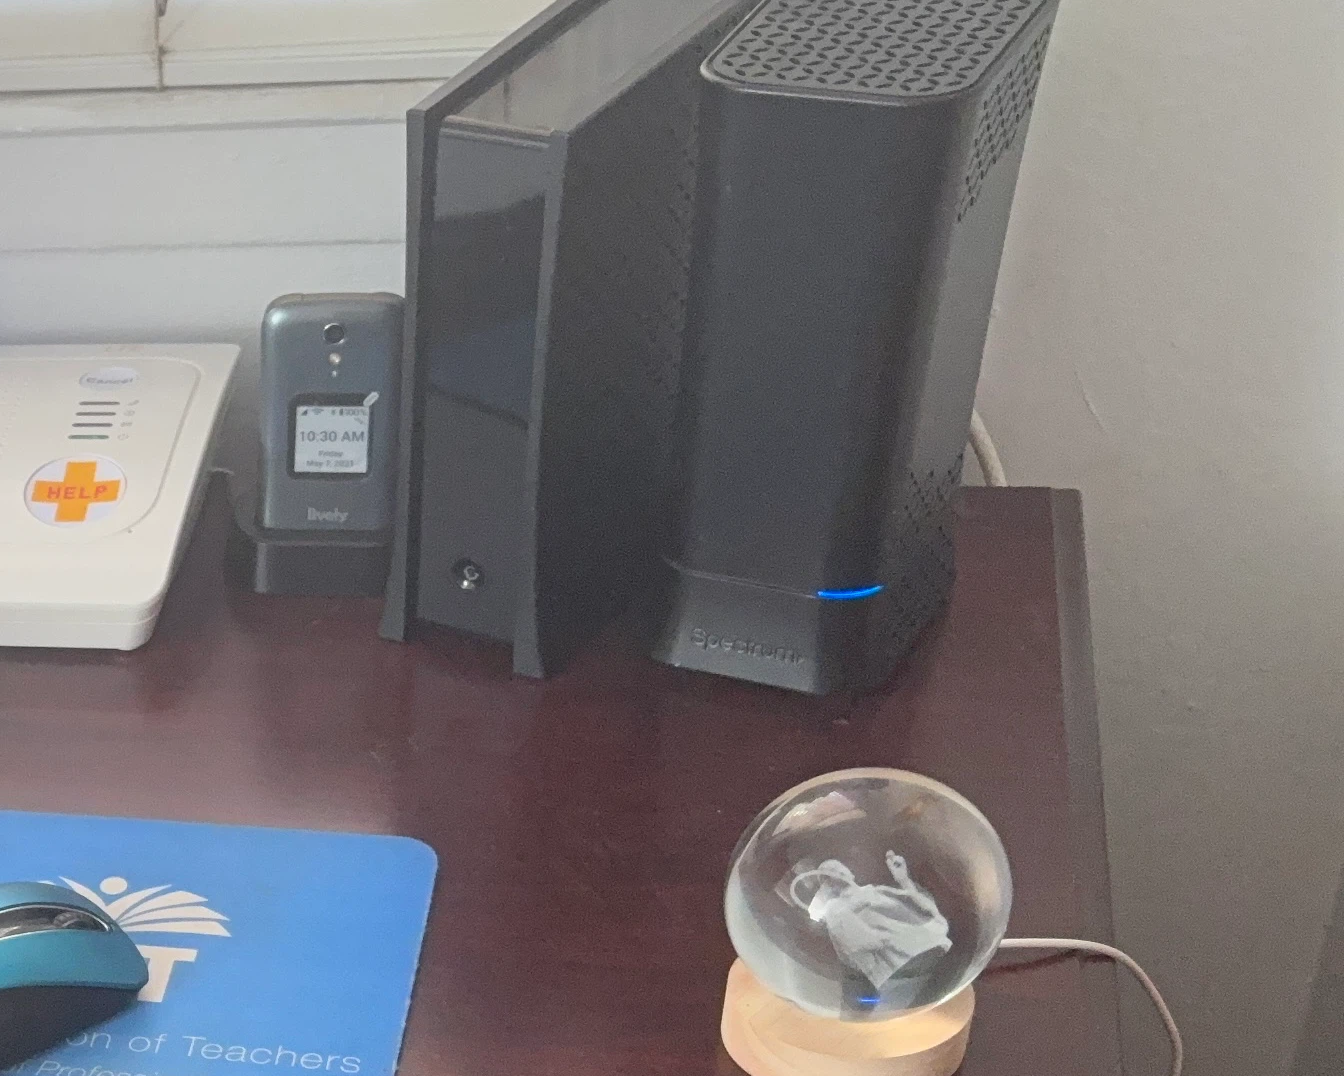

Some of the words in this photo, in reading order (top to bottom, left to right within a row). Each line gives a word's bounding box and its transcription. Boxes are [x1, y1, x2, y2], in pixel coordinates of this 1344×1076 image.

[300, 430, 338, 442] 10:30
[341, 430, 365, 442] AM
[46, 484, 108, 501] HELP
[692, 628, 795, 663] Spectrum
[128, 1026, 168, 1055] of
[182, 1034, 362, 1076] Teachers
